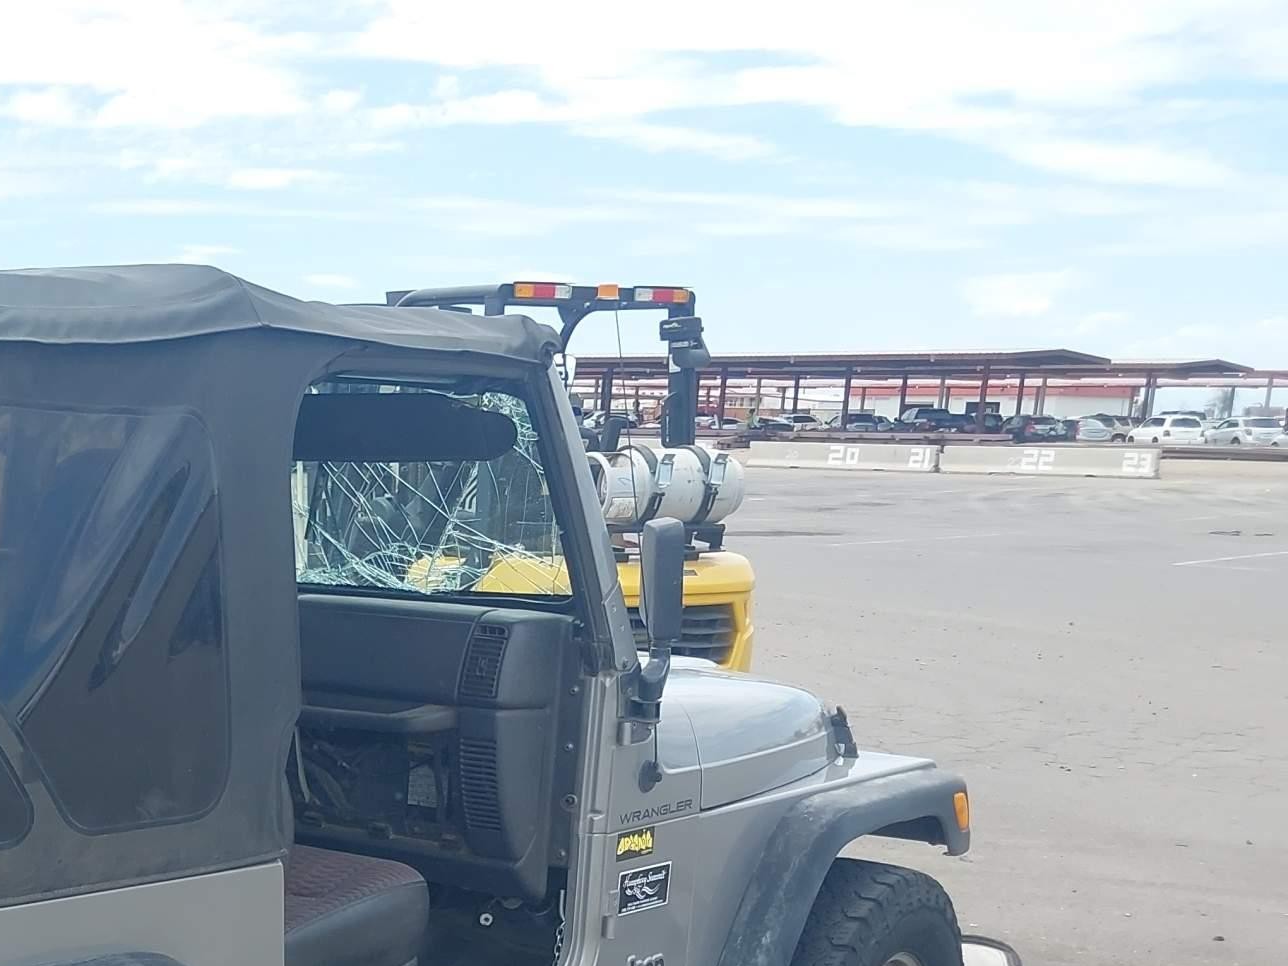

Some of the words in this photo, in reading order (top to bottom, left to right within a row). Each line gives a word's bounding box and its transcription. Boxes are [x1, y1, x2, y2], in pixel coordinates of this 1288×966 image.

[827, 445, 860, 466] 20
[908, 447, 931, 469] 21
[1021, 449, 1056, 471] 22
[1122, 452, 1153, 473] 23
[619, 799, 693, 825] WRANGLER
